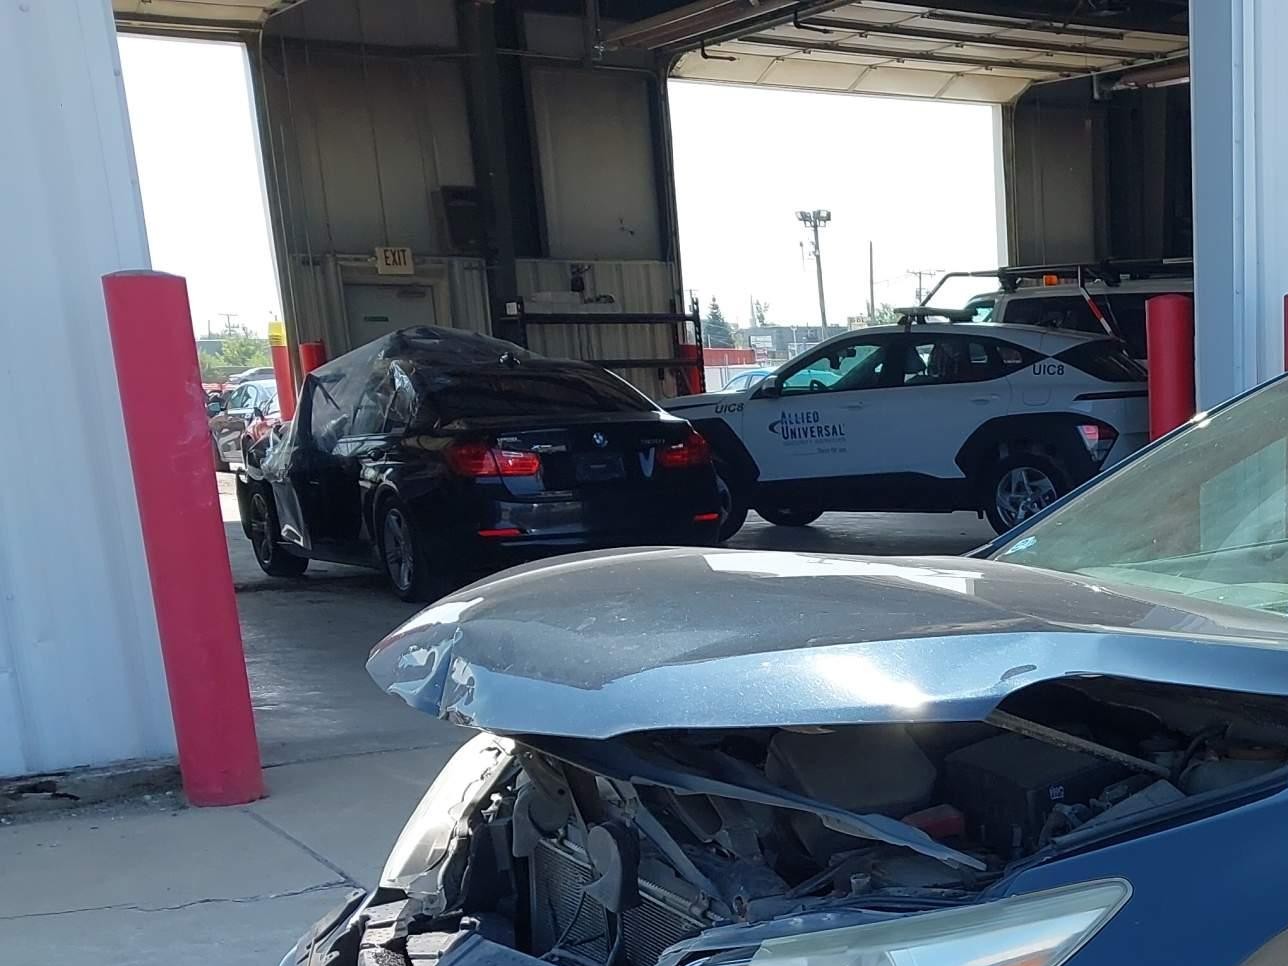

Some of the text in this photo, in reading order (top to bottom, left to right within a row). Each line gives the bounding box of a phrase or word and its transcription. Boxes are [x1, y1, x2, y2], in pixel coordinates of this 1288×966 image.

[384, 249, 406, 266] EXIT
[1033, 364, 1064, 376] UIC8
[715, 403, 744, 414] UIC8
[780, 411, 819, 425] ALLIED
[781, 424, 846, 440] UNIVERSAL
